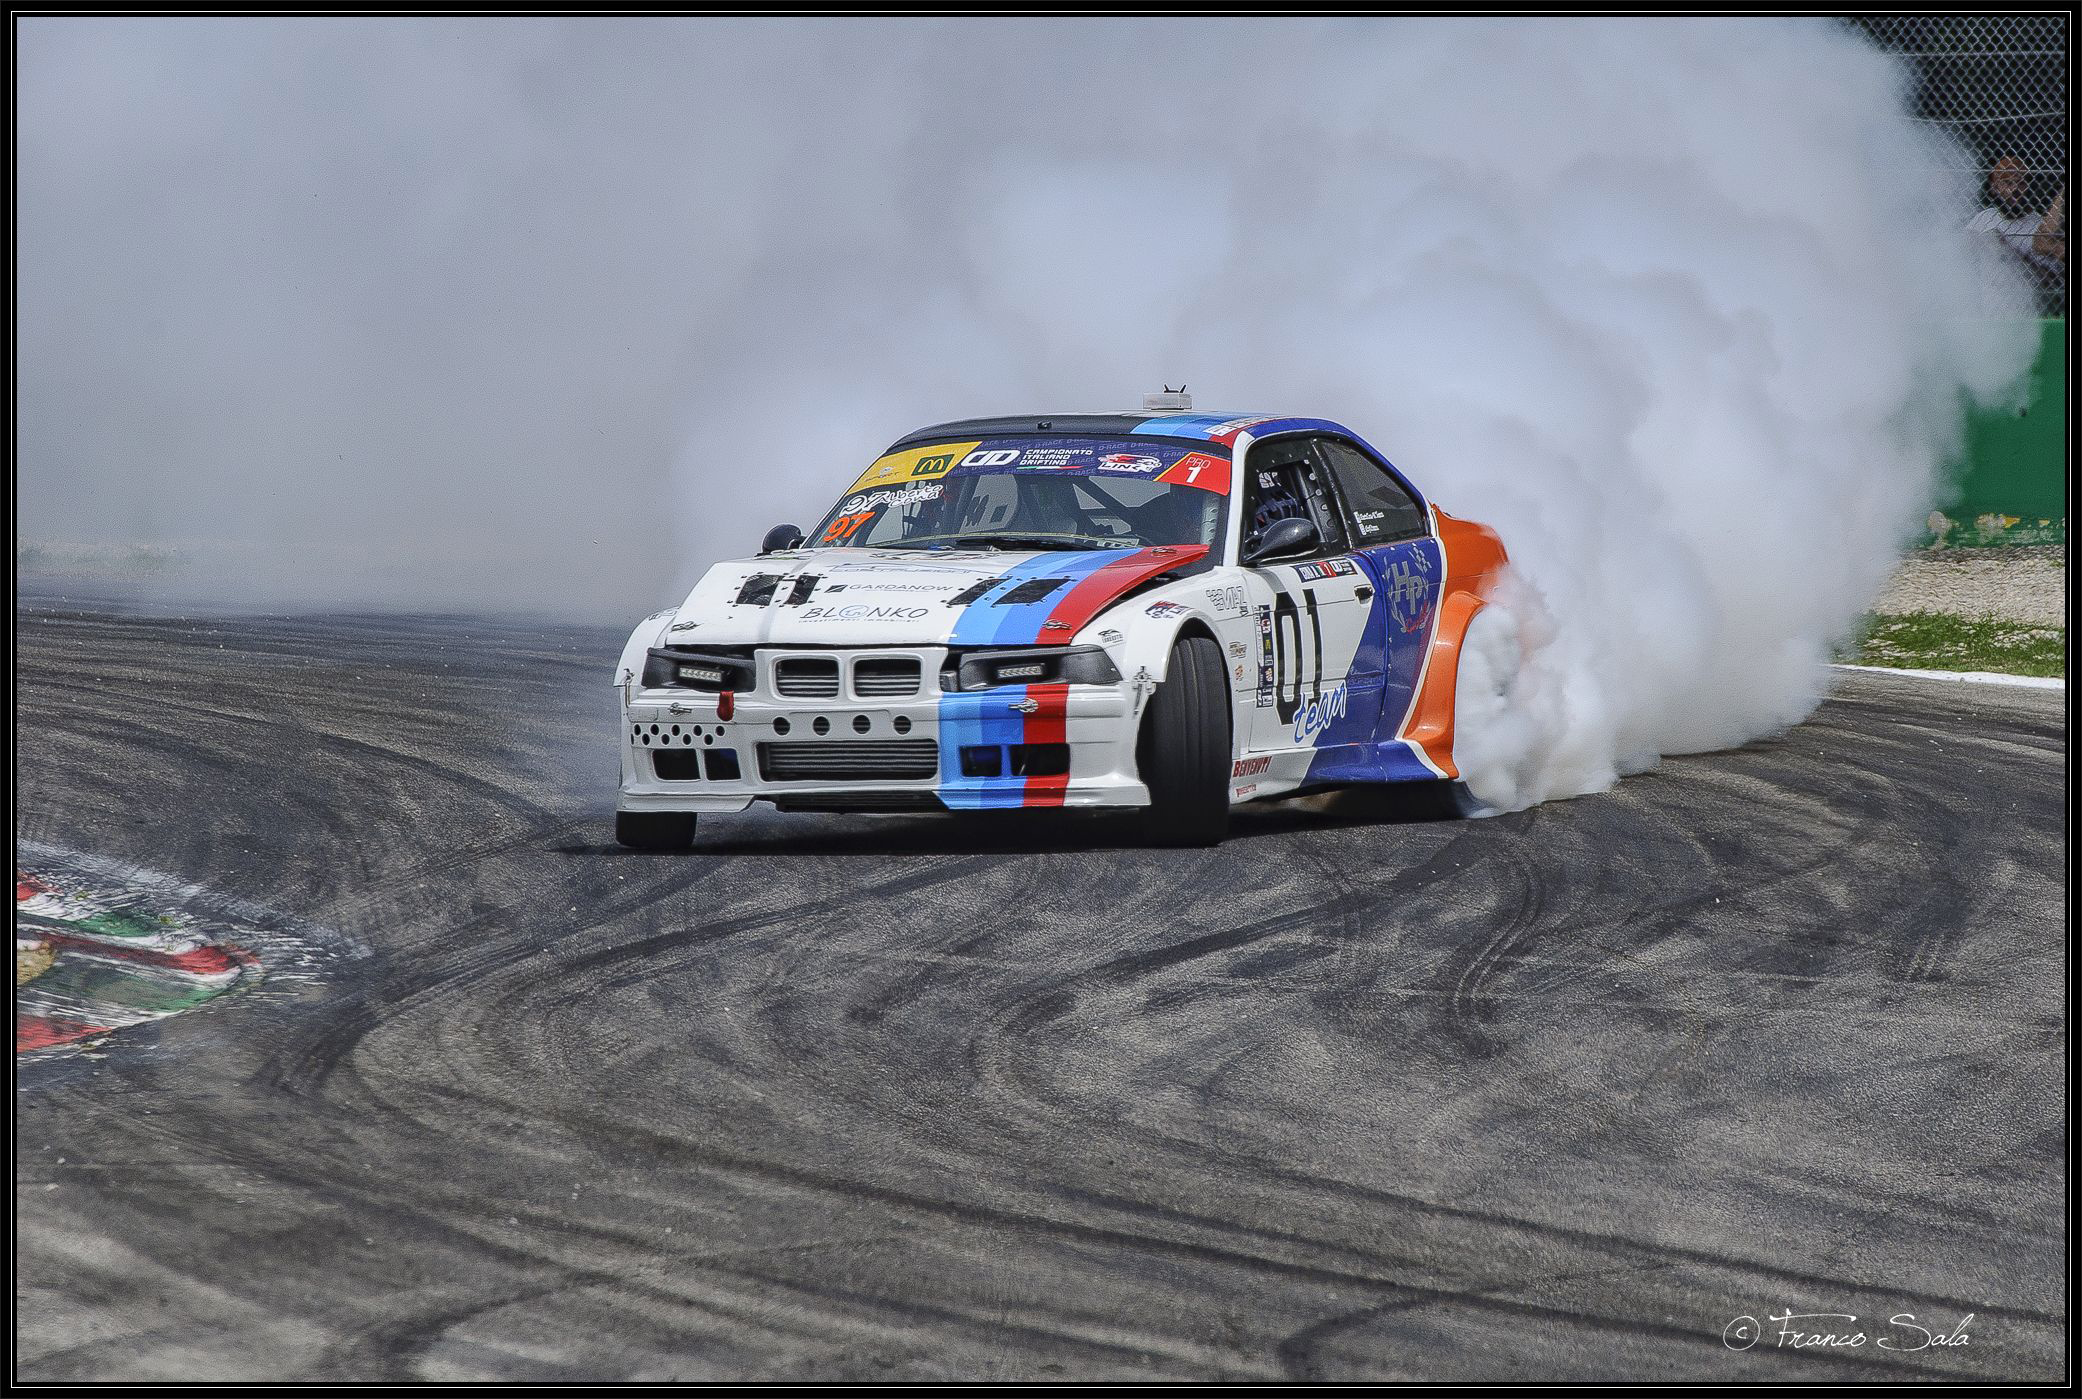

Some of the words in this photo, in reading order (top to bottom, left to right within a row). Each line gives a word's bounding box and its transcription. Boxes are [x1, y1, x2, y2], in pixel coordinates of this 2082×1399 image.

[1186, 456, 1211, 469] PRO
[1186, 467, 1202, 483] 1
[839, 490, 891, 517] 97
[822, 511, 876, 542] 97
[1273, 588, 1323, 725] 01
[1293, 680, 1348, 743] team
